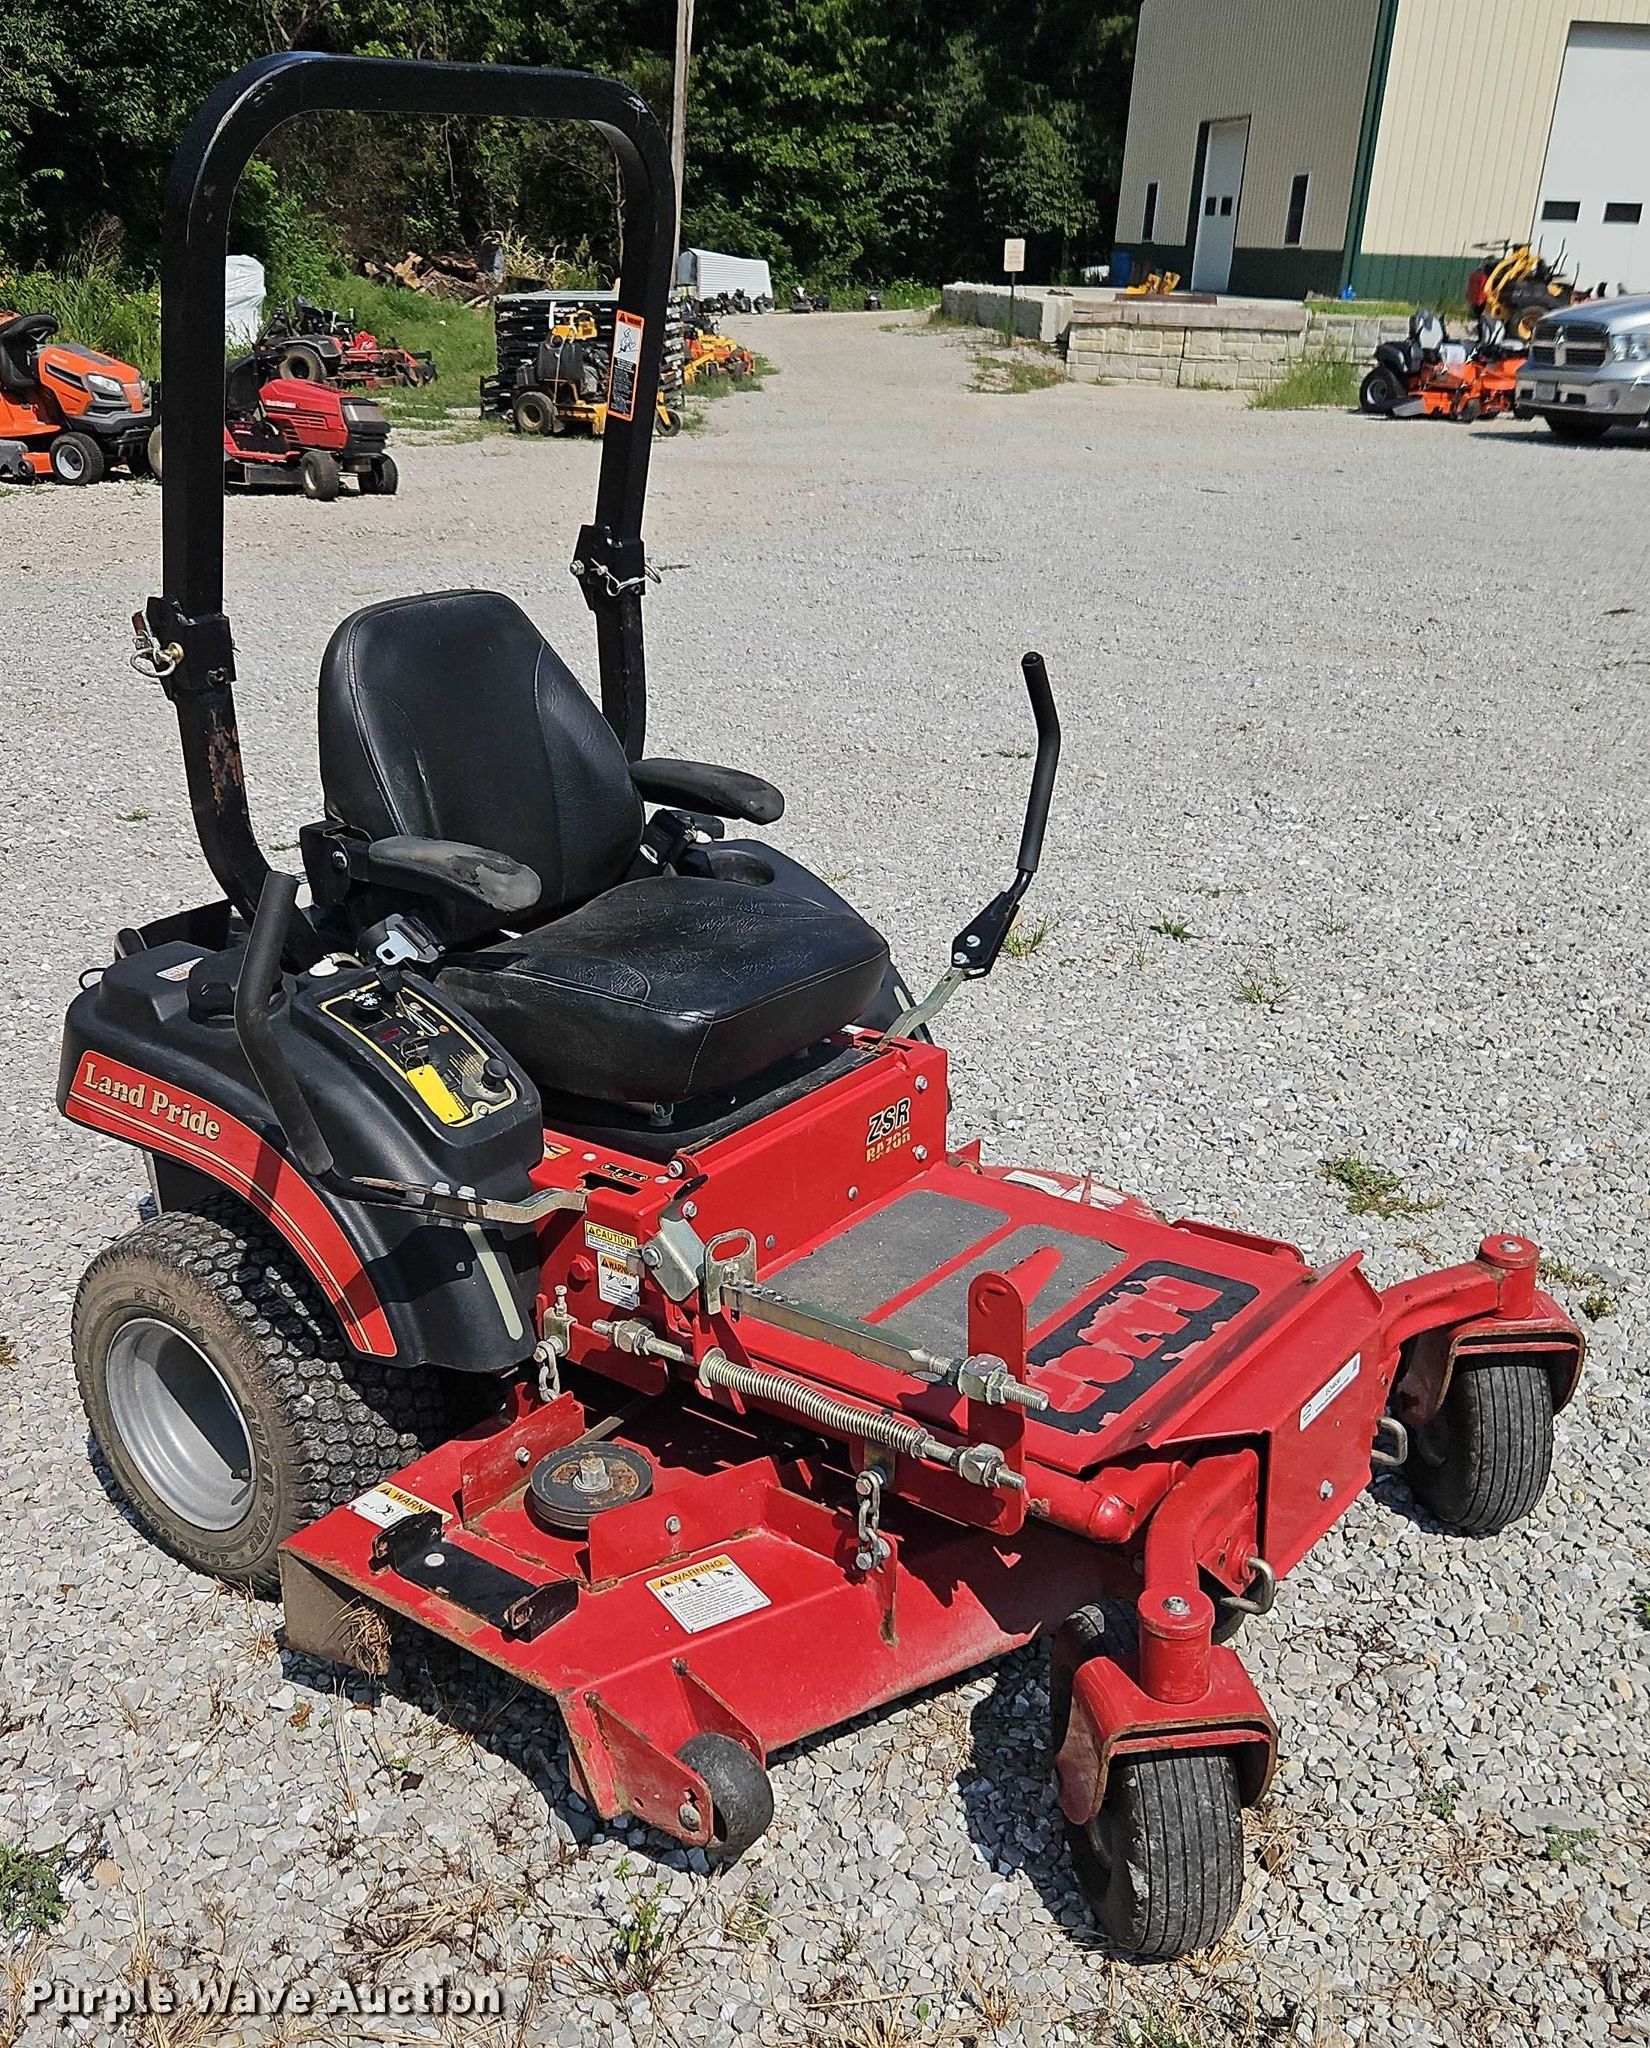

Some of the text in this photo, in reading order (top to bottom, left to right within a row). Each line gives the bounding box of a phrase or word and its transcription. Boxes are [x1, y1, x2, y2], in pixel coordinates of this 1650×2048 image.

[83, 1062, 221, 1140] Land Pride
[866, 1097, 911, 1146] ZSR
[595, 1228, 632, 1247] CAUTION
[134, 1286, 209, 1346] KENDA
[249, 1502, 274, 1553] TURF
[671, 1559, 723, 1582] WARNING
